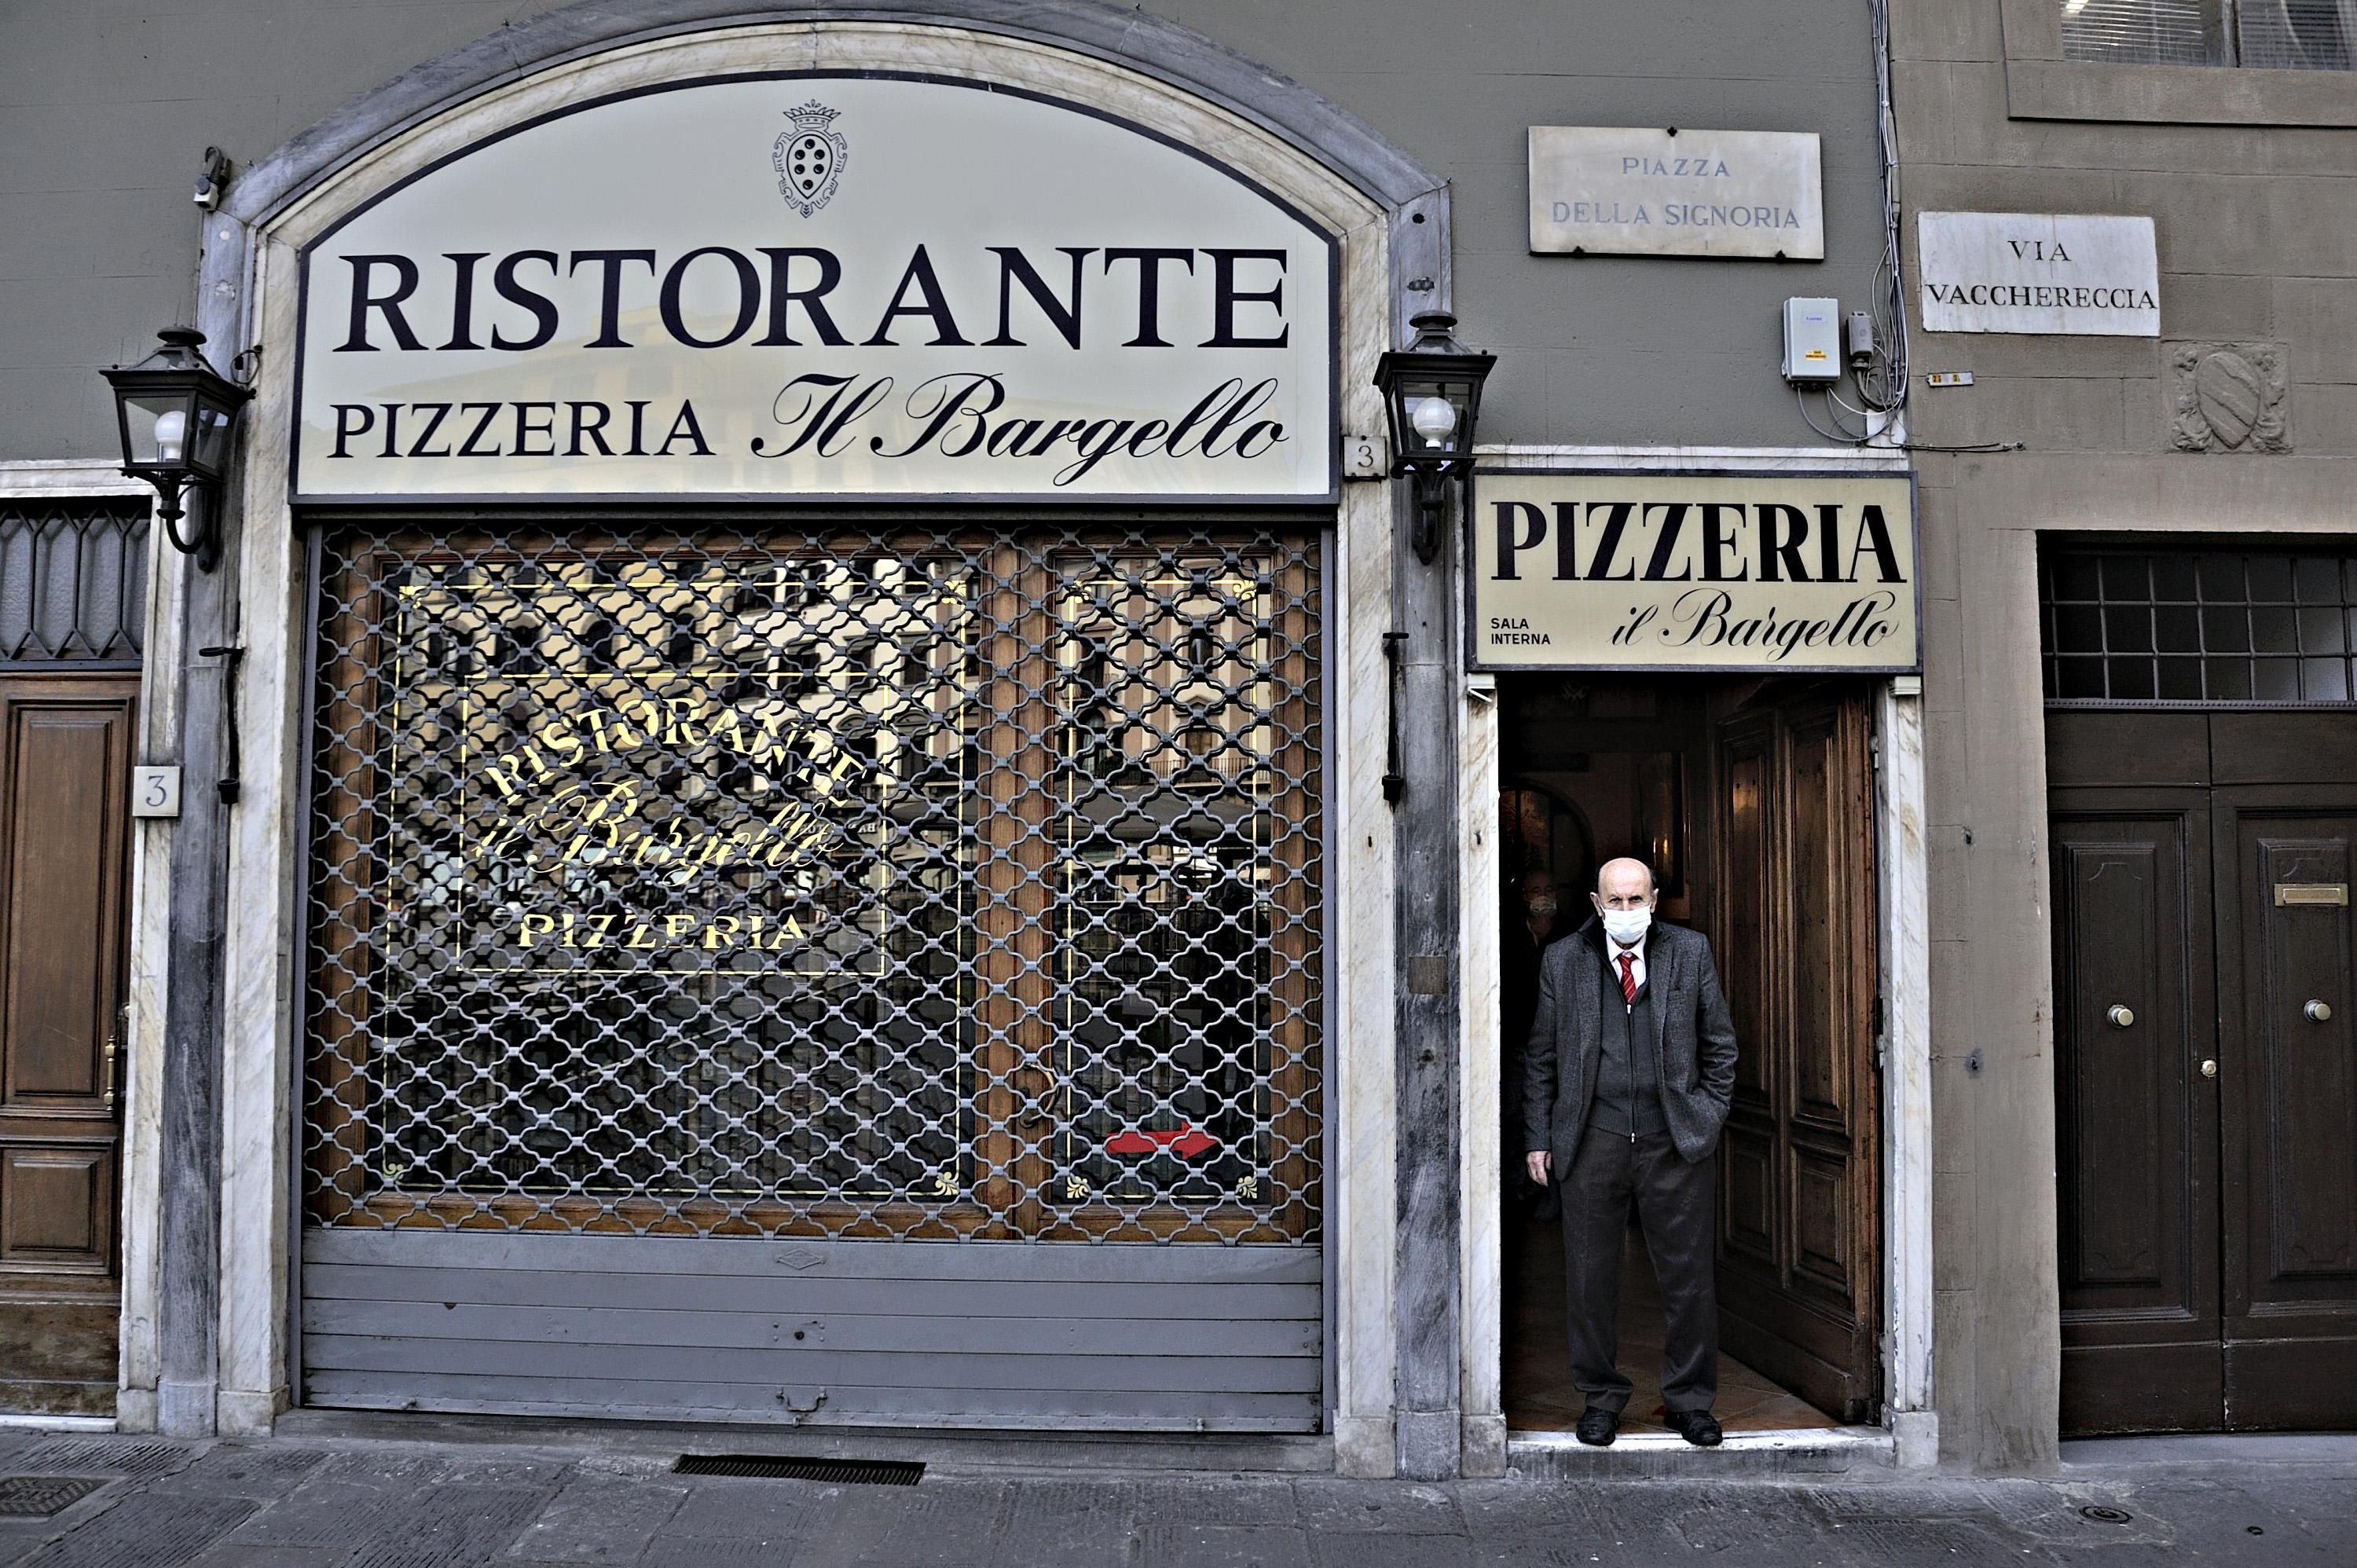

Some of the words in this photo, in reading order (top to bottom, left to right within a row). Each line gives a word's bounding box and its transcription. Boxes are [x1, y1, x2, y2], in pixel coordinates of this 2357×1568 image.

[1622, 157, 1730, 178] PIAZZA
[1552, 201, 1651, 225] DELLA
[1665, 203, 1801, 229] SIGNORIA
[2007, 240, 2072, 262] VIA
[332, 244, 1289, 352] RISTORANTE
[1925, 283, 2157, 310] VACCHERECCIA
[327, 399, 717, 458] PIZZERIA
[751, 373, 893, 458] Il
[870, 372, 1289, 487] Bargello
[1358, 445, 1374, 468] 3
[1490, 500, 1908, 584] PIZZERIA
[1490, 617, 1530, 629] SALA
[1606, 603, 1659, 646] il
[1657, 588, 1899, 662] Bargello
[1490, 633, 1551, 645] INTERNA
[485, 698, 867, 808] RISTORANTE
[145, 775, 167, 808] 3
[518, 913, 814, 950] PIZZERIA
